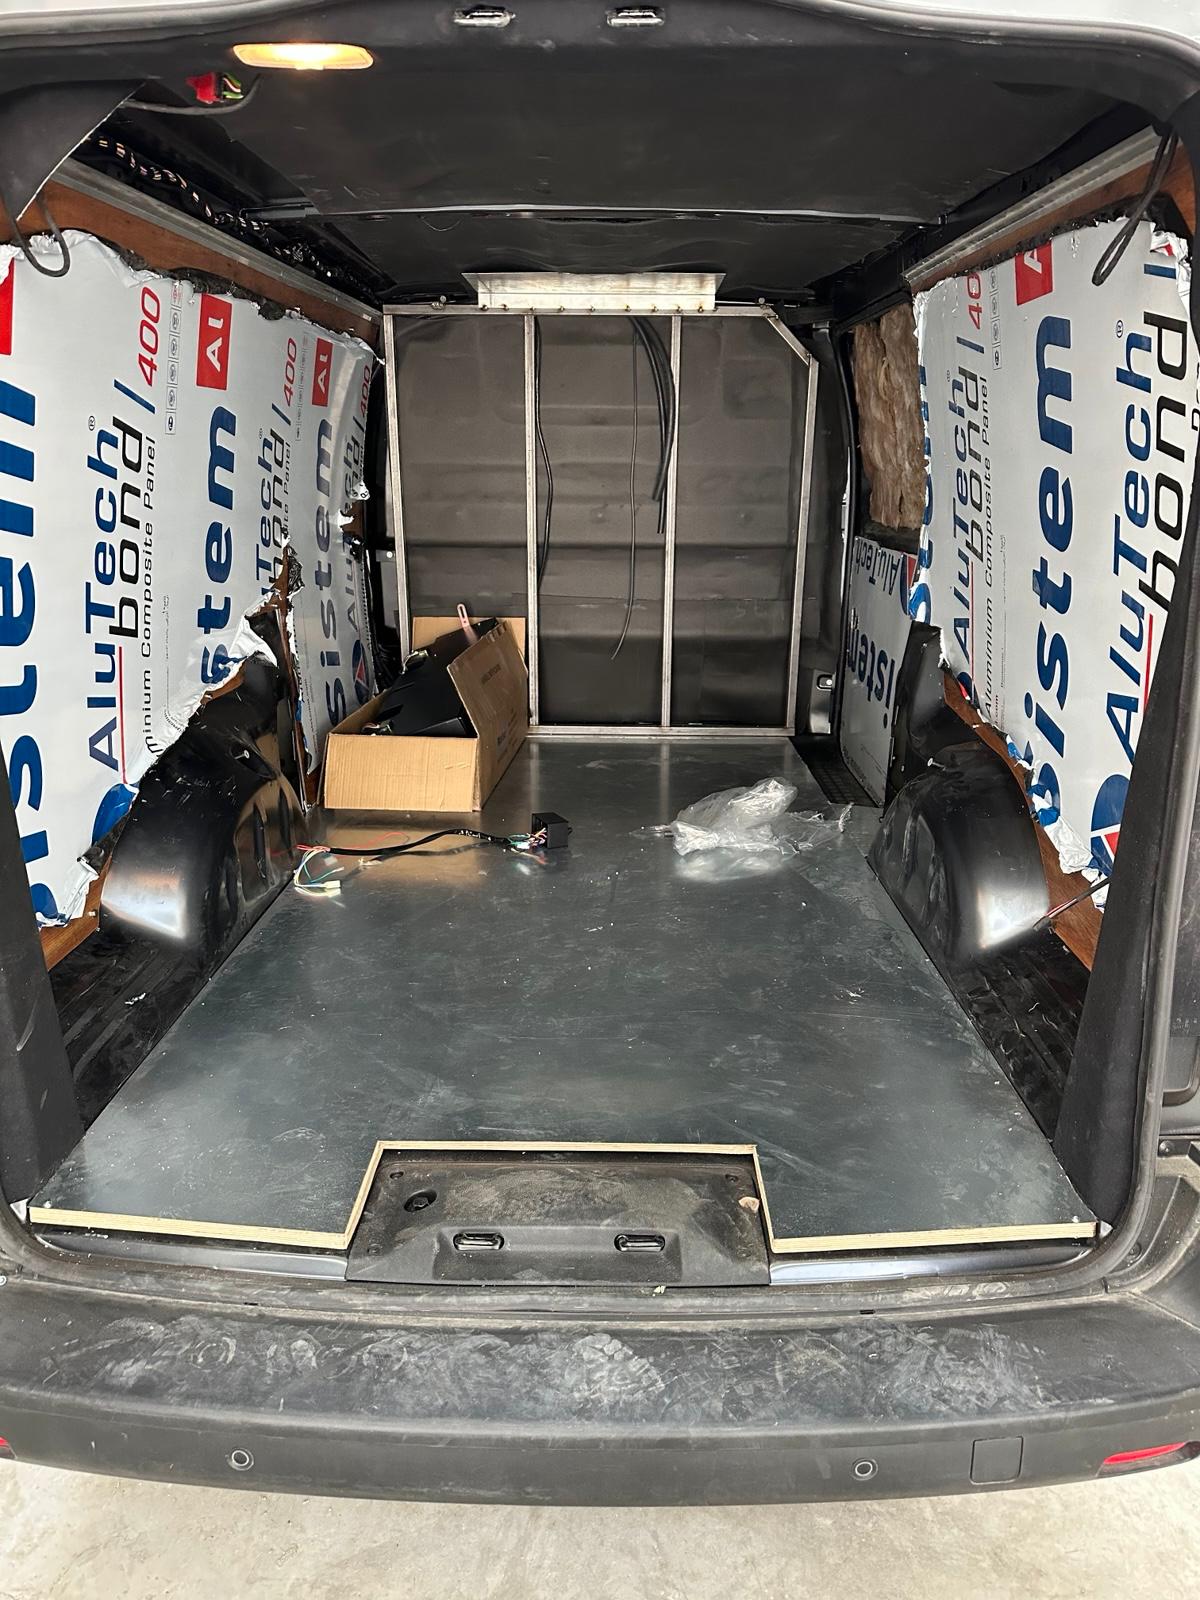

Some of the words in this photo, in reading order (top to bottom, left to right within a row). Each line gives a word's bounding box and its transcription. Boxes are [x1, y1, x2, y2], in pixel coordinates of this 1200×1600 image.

[143, 436, 156, 510] Panel
[958, 367, 984, 562] bond
[979, 376, 990, 445] Panel
[109, 416, 143, 638] bond
[315, 419, 347, 726] Sistem
[983, 456, 993, 587] Composite
[141, 522, 154, 657] Composite
[983, 598, 993, 720] Aluminium
